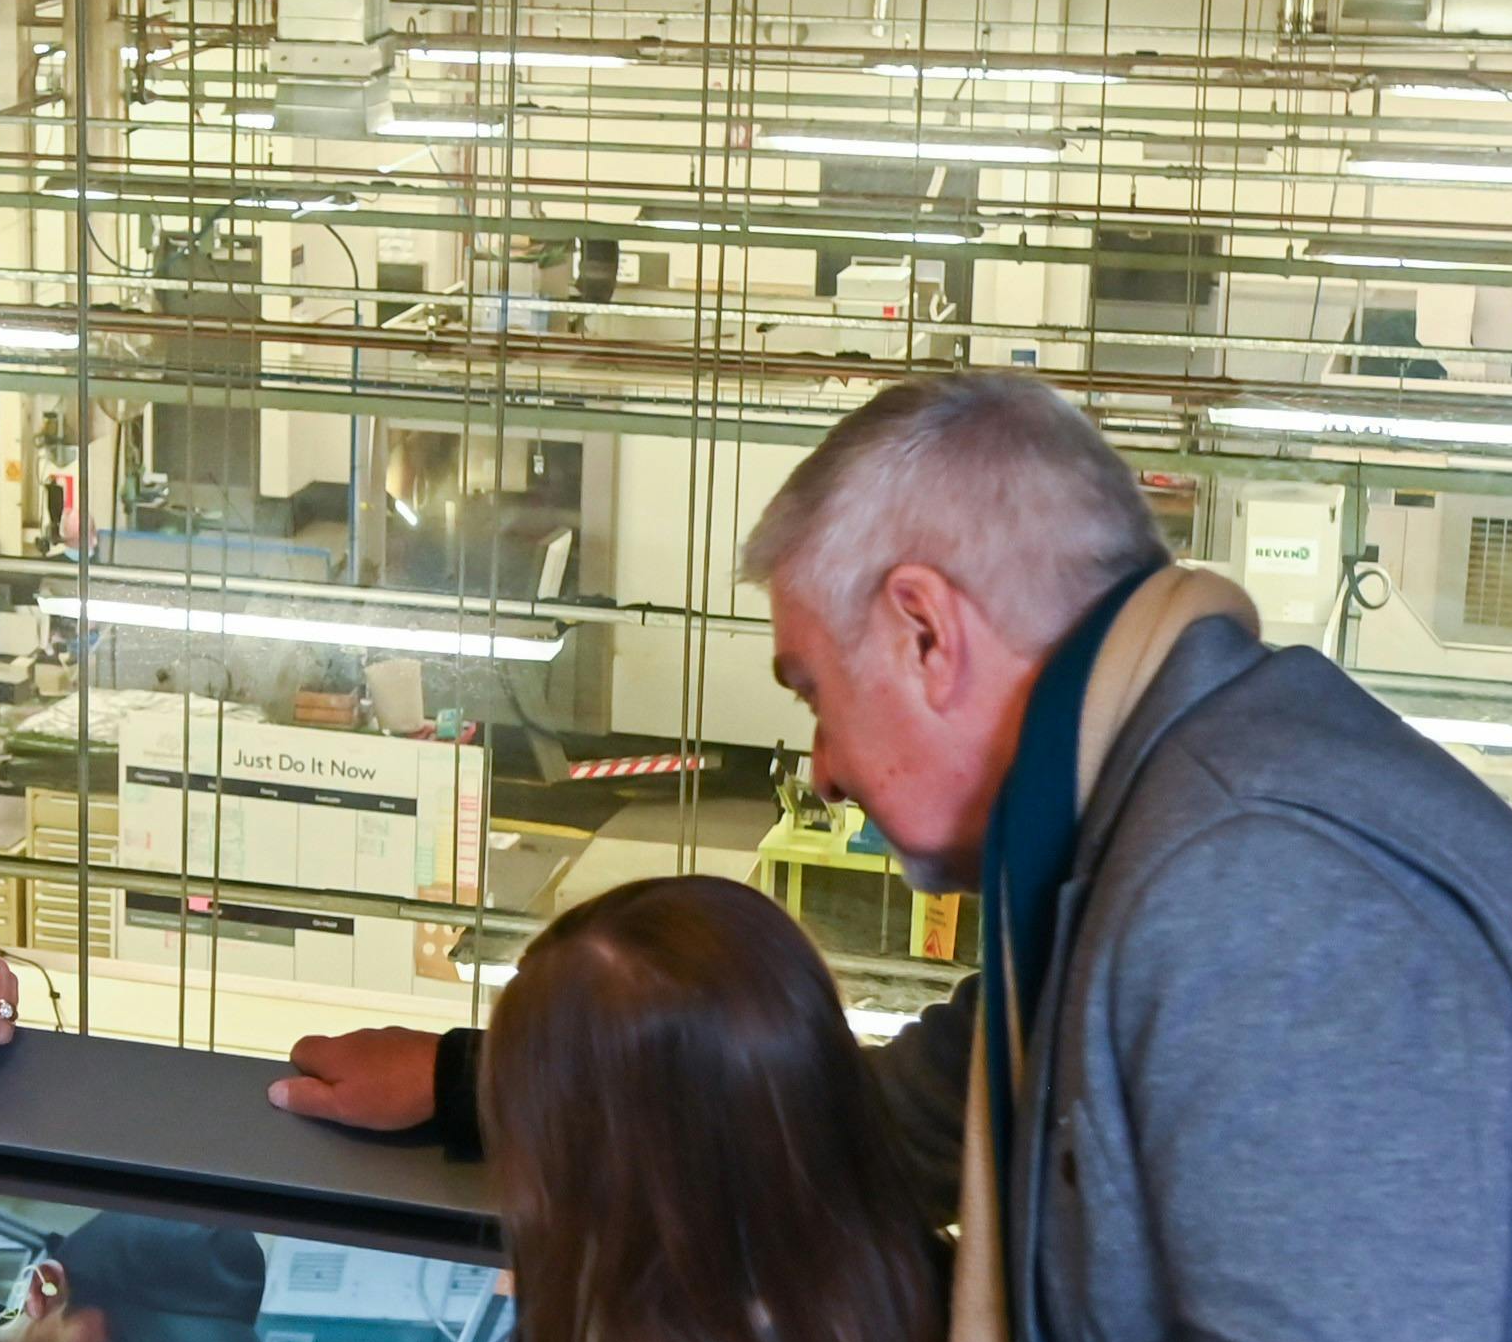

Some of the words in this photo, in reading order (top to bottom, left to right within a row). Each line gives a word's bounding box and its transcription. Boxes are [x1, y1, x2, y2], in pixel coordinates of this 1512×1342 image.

[234, 749, 273, 770] Just
[279, 755, 304, 774] Do
[312, 758, 323, 776] It
[331, 760, 376, 780] Now
